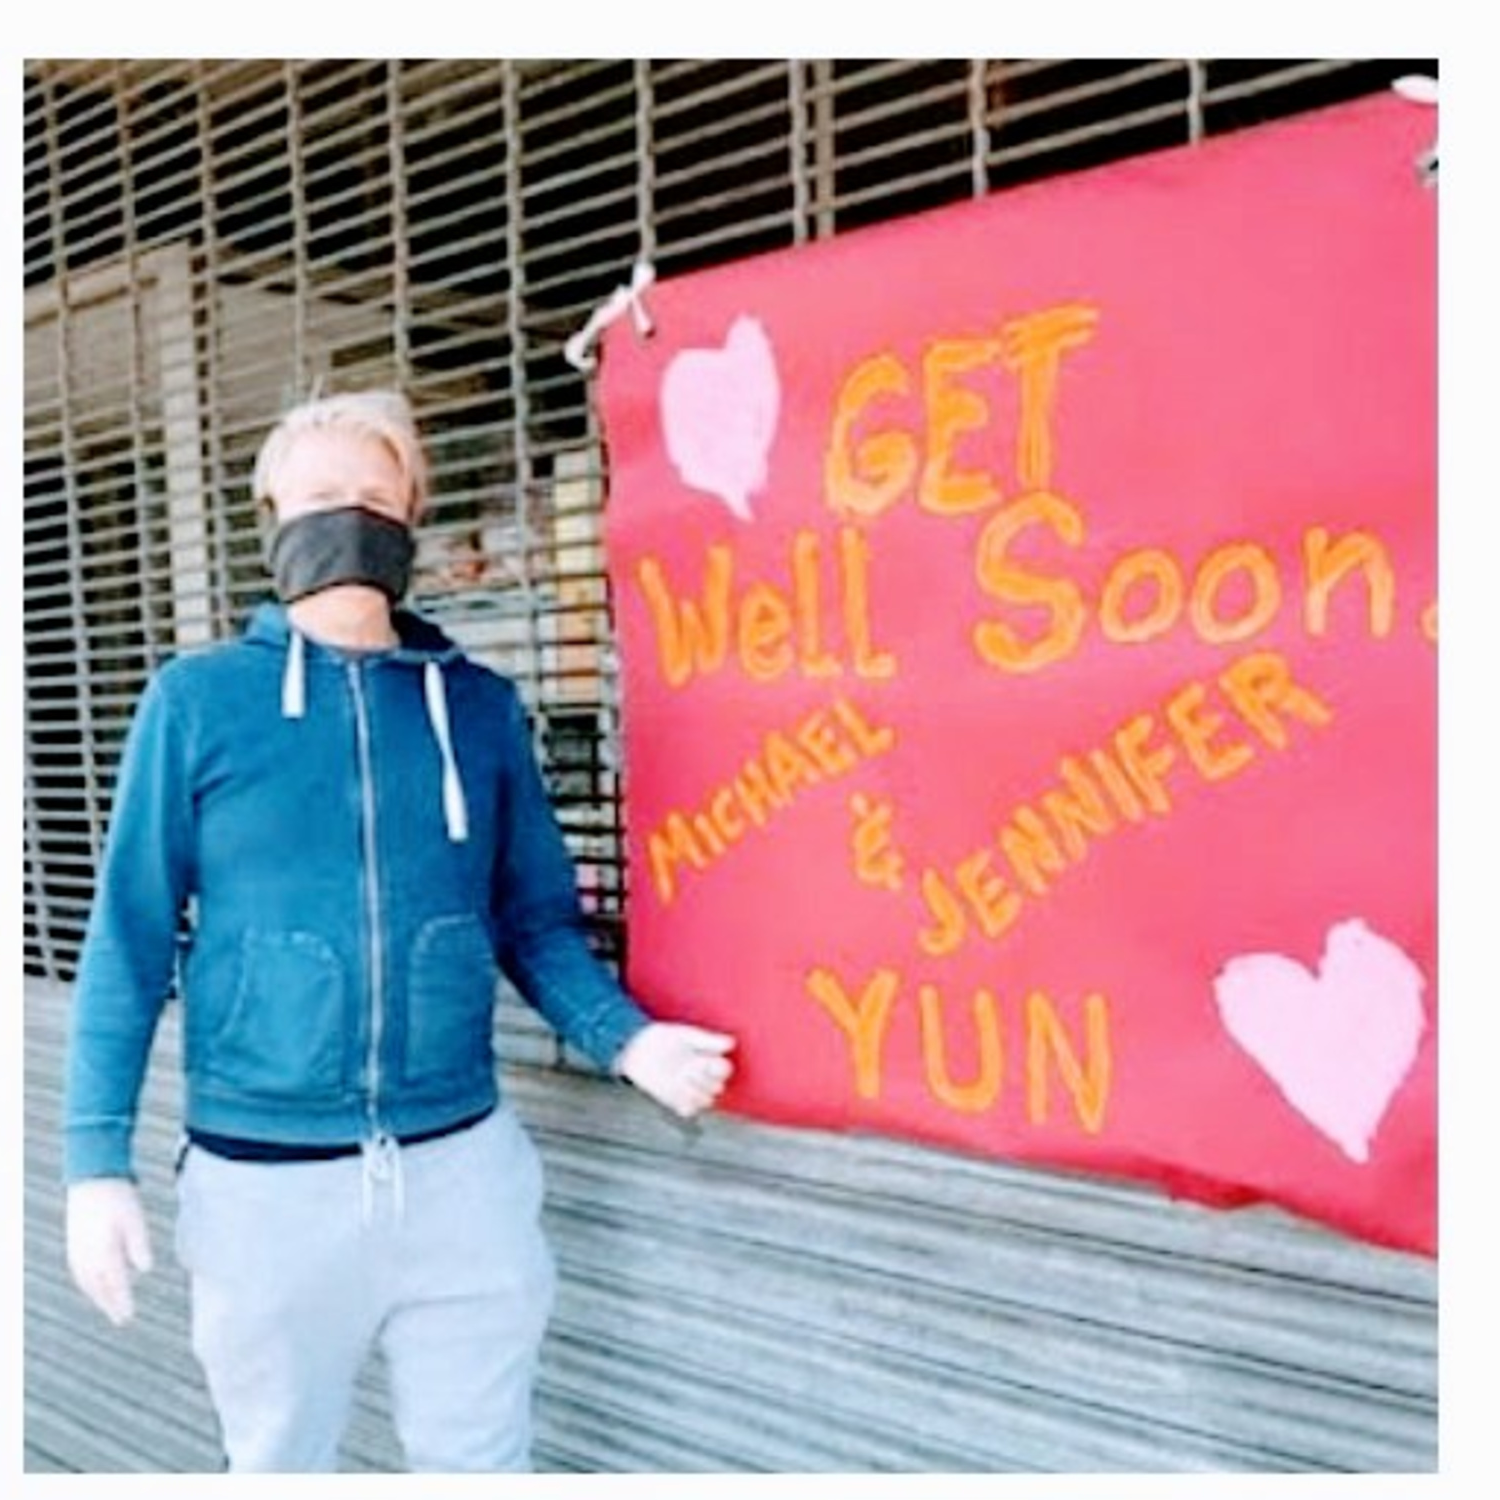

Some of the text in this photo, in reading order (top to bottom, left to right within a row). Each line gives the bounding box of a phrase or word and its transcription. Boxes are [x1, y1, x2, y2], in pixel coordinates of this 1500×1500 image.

[821, 301, 1098, 518] GET
[970, 490, 1438, 676] Soon
[646, 700, 894, 906] MICHAEL
[846, 793, 902, 892] &
[914, 648, 1332, 958] JENNIFER
[806, 966, 1114, 1134] YUN
